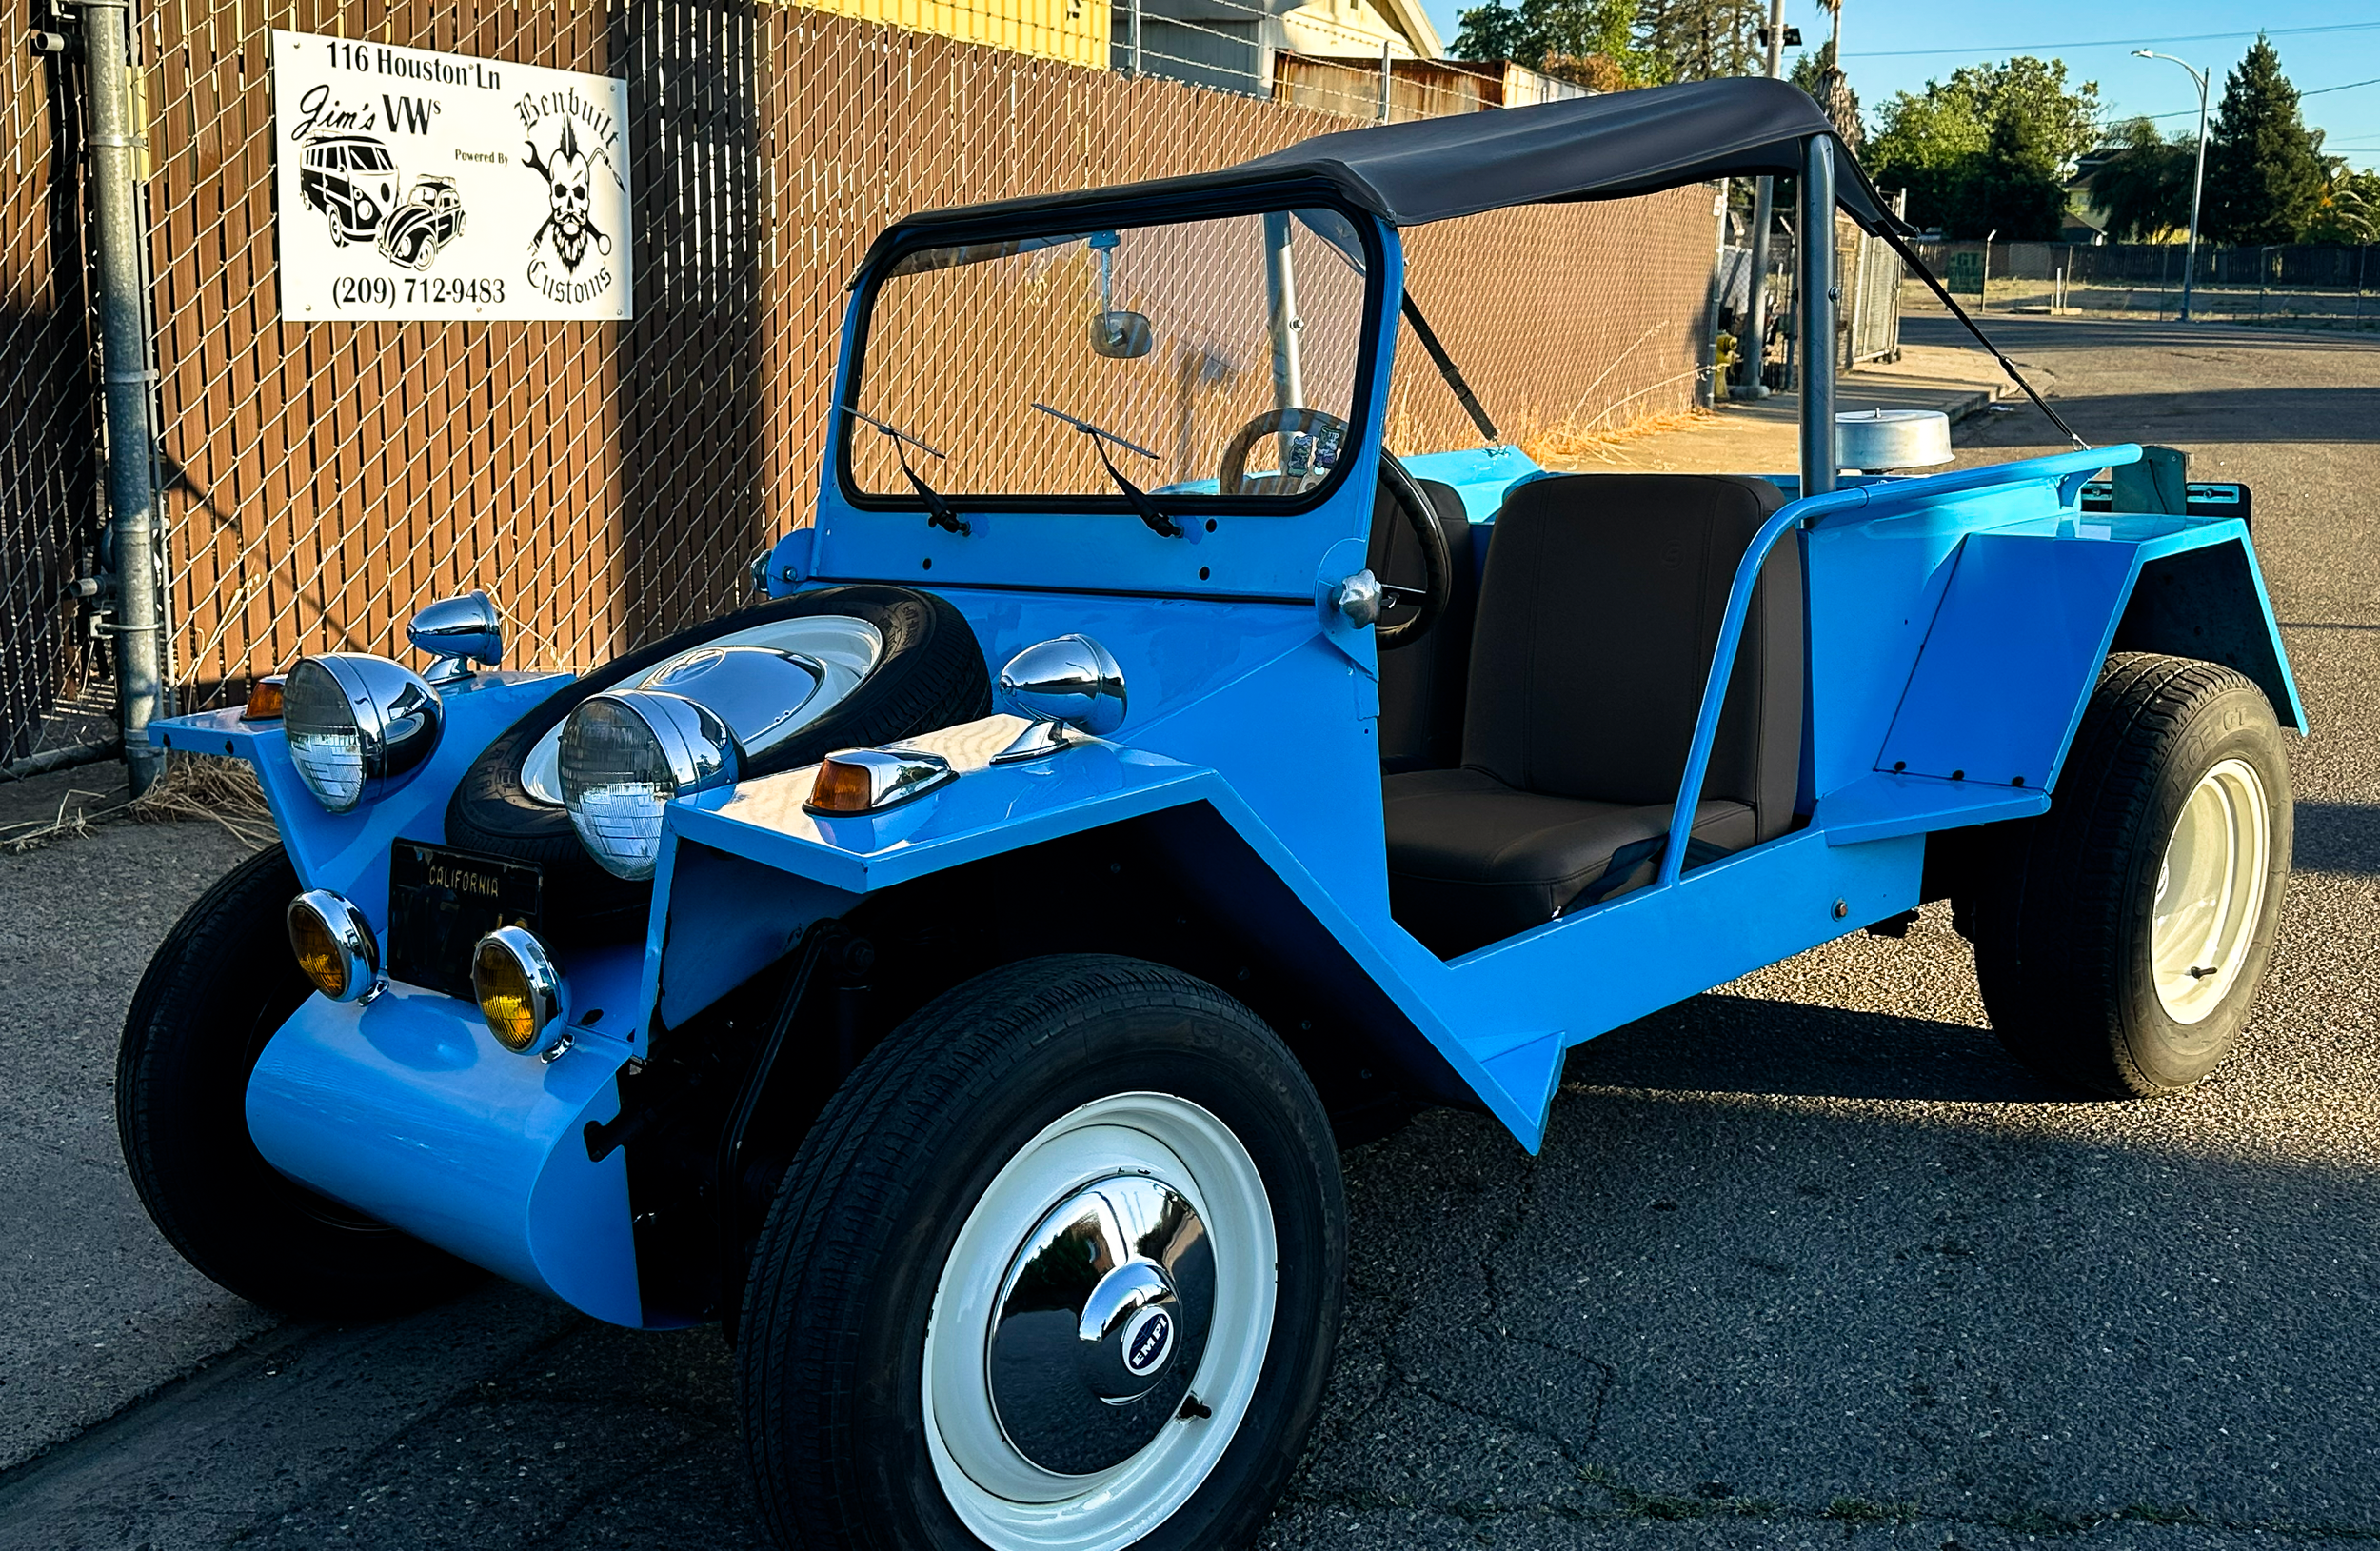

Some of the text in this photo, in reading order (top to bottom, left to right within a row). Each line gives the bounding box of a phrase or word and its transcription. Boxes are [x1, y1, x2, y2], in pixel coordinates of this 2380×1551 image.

[327, 41, 501, 90] 116 Houston Ln
[291, 84, 376, 141] Jim's
[514, 87, 620, 150] Benbuilt
[455, 149, 508, 168] Powered By
[332, 275, 506, 309] (209) 712-9483
[527, 258, 612, 305] Customs
[428, 865, 499, 898] CALIFORNIA
[1132, 1316, 1168, 1367] EMPI
